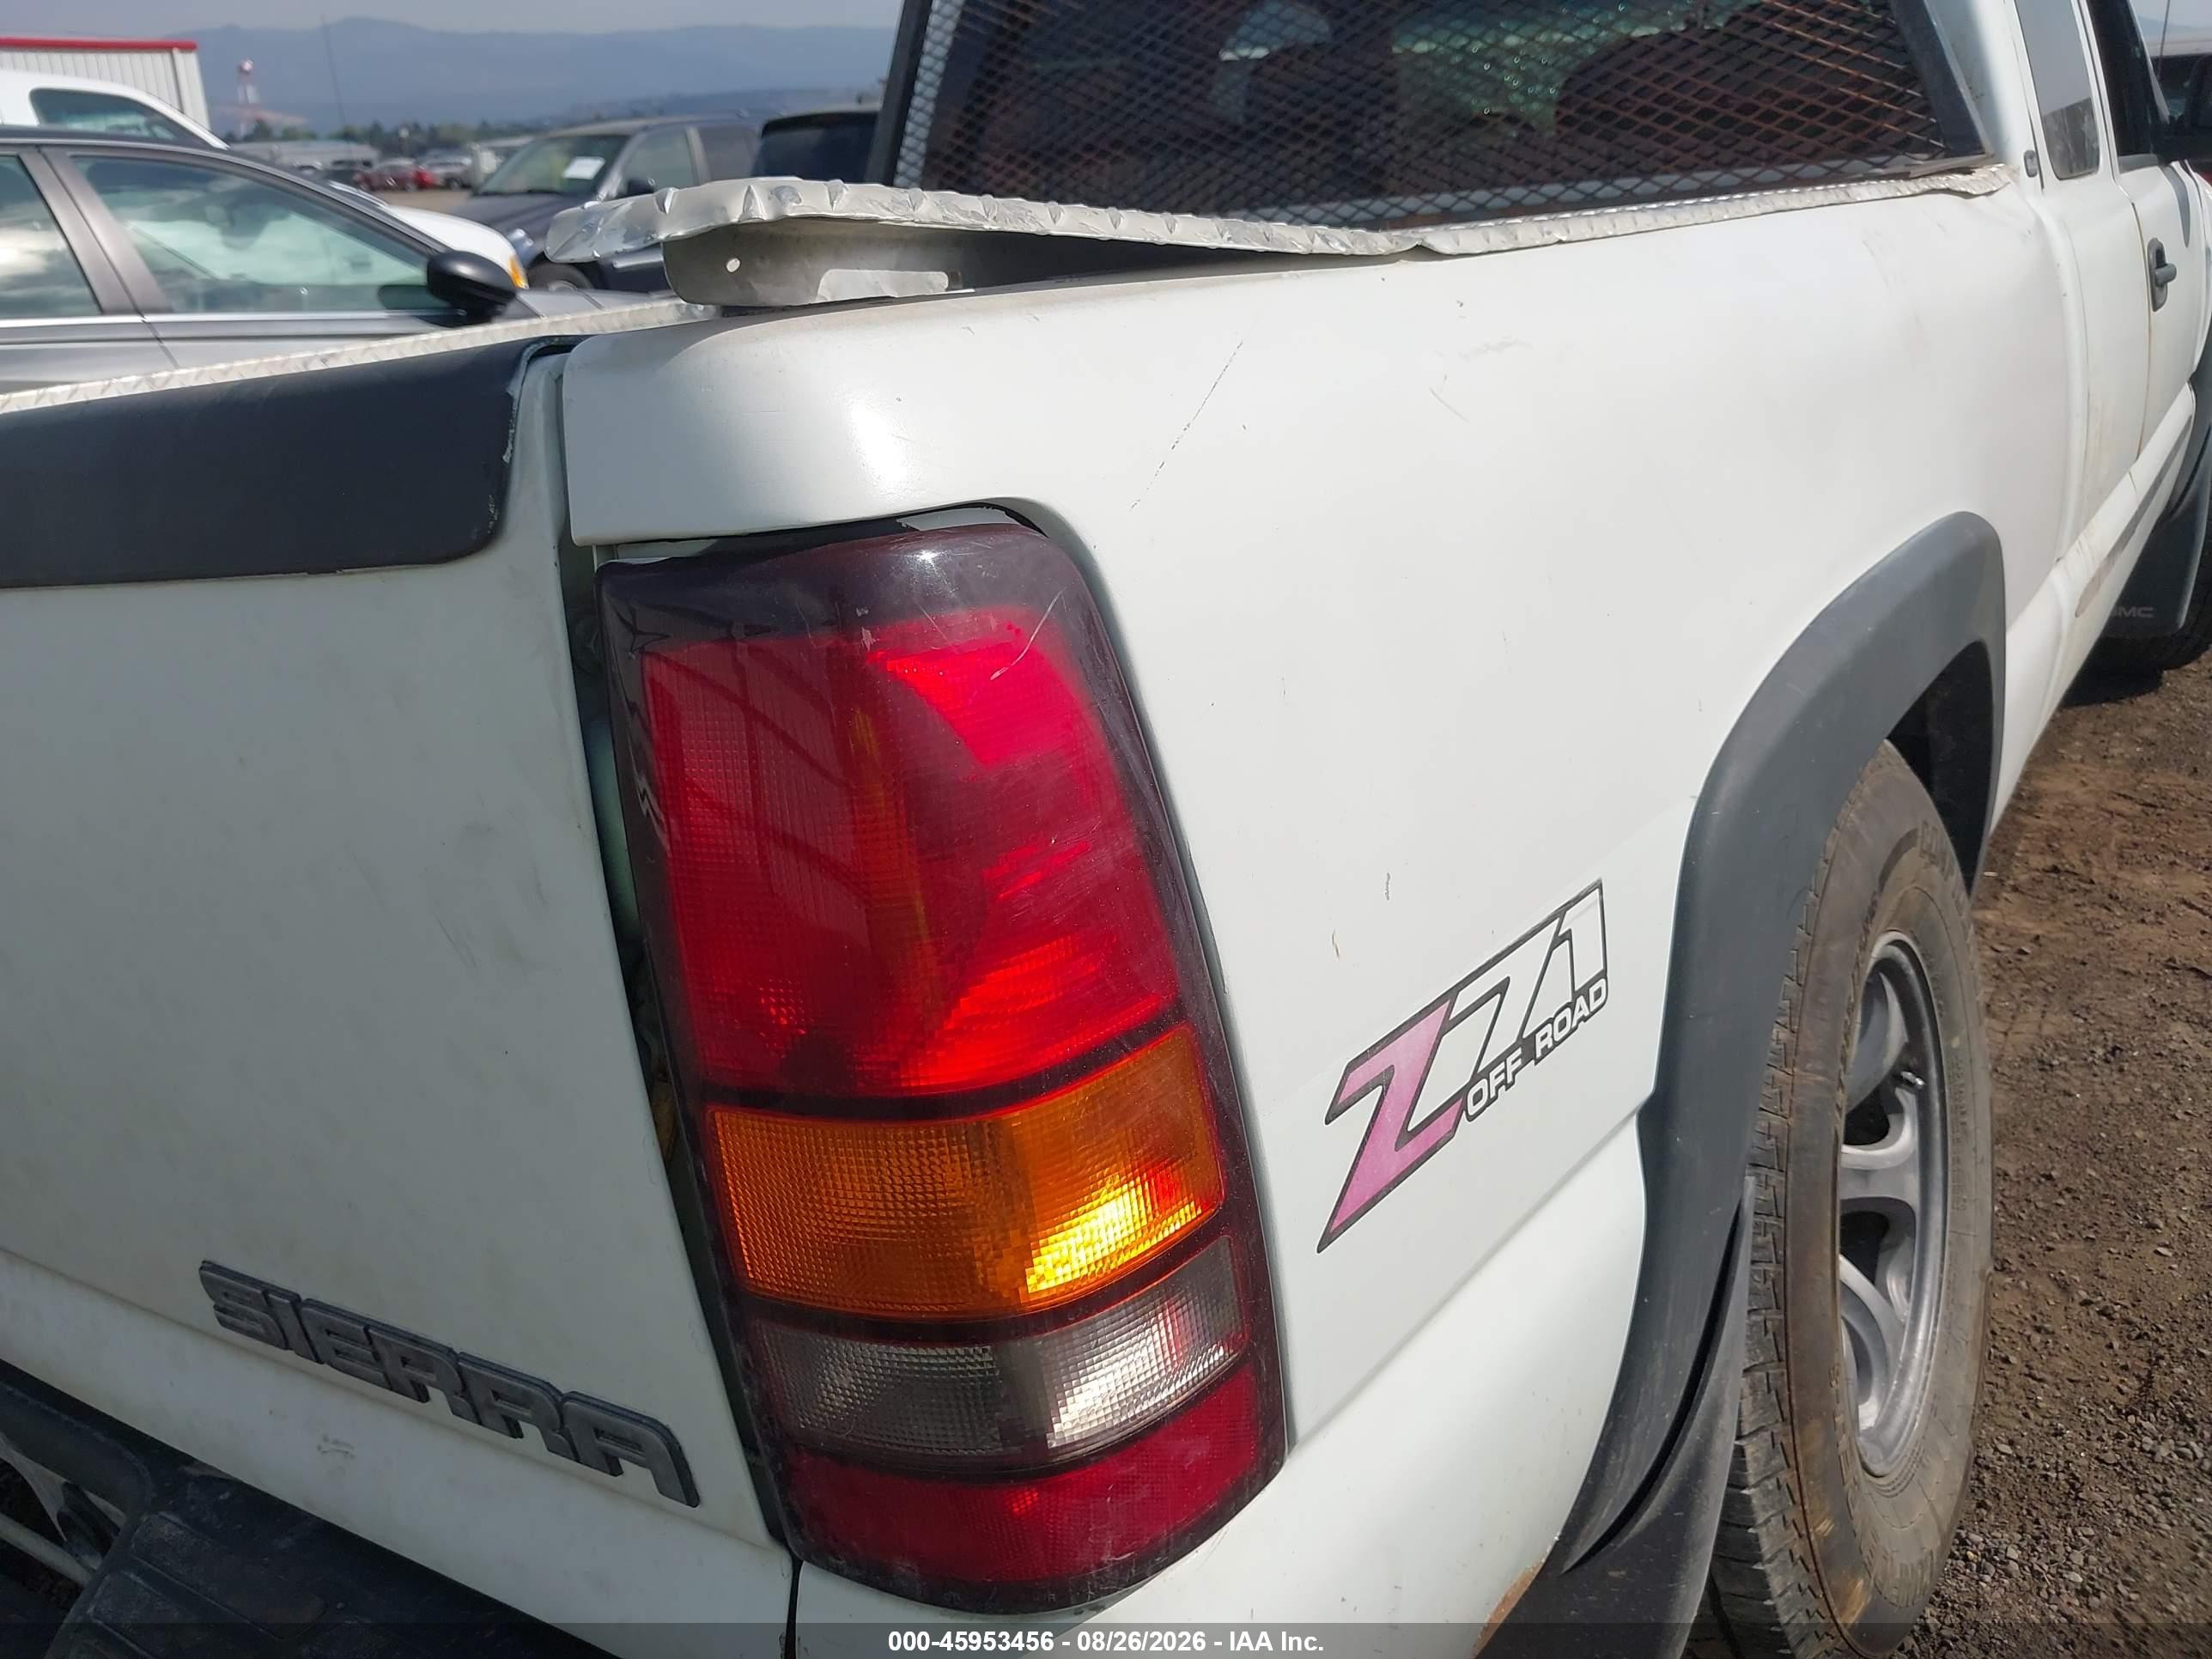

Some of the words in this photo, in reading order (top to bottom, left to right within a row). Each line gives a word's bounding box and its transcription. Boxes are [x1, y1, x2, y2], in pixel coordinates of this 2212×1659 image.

[1316, 878, 1607, 1252] Z71
[1465, 1046, 1522, 1118] OFF
[1534, 976, 1607, 1060] ROAD
[198, 1260, 701, 1509] SIERRA
